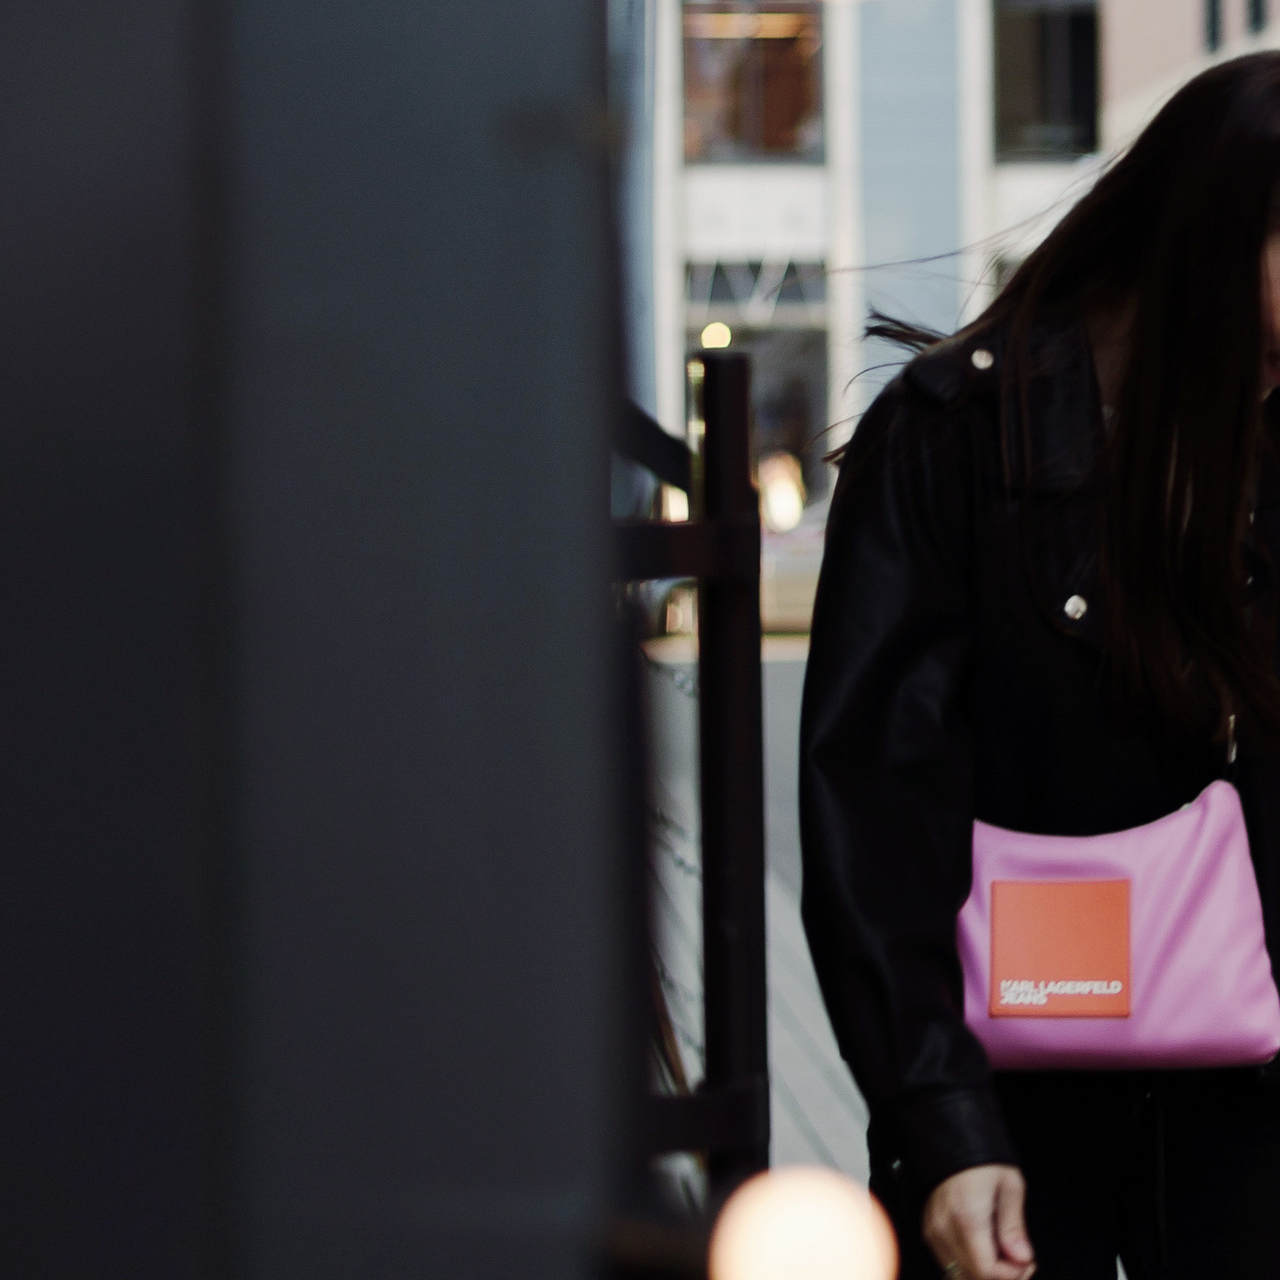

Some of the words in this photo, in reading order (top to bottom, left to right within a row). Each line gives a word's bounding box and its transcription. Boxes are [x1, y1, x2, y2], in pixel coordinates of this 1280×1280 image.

[1000, 980, 1038, 994] KARL
[1036, 980, 1122, 994] LAGERFELD
[1000, 992, 1047, 1005] JEANS
